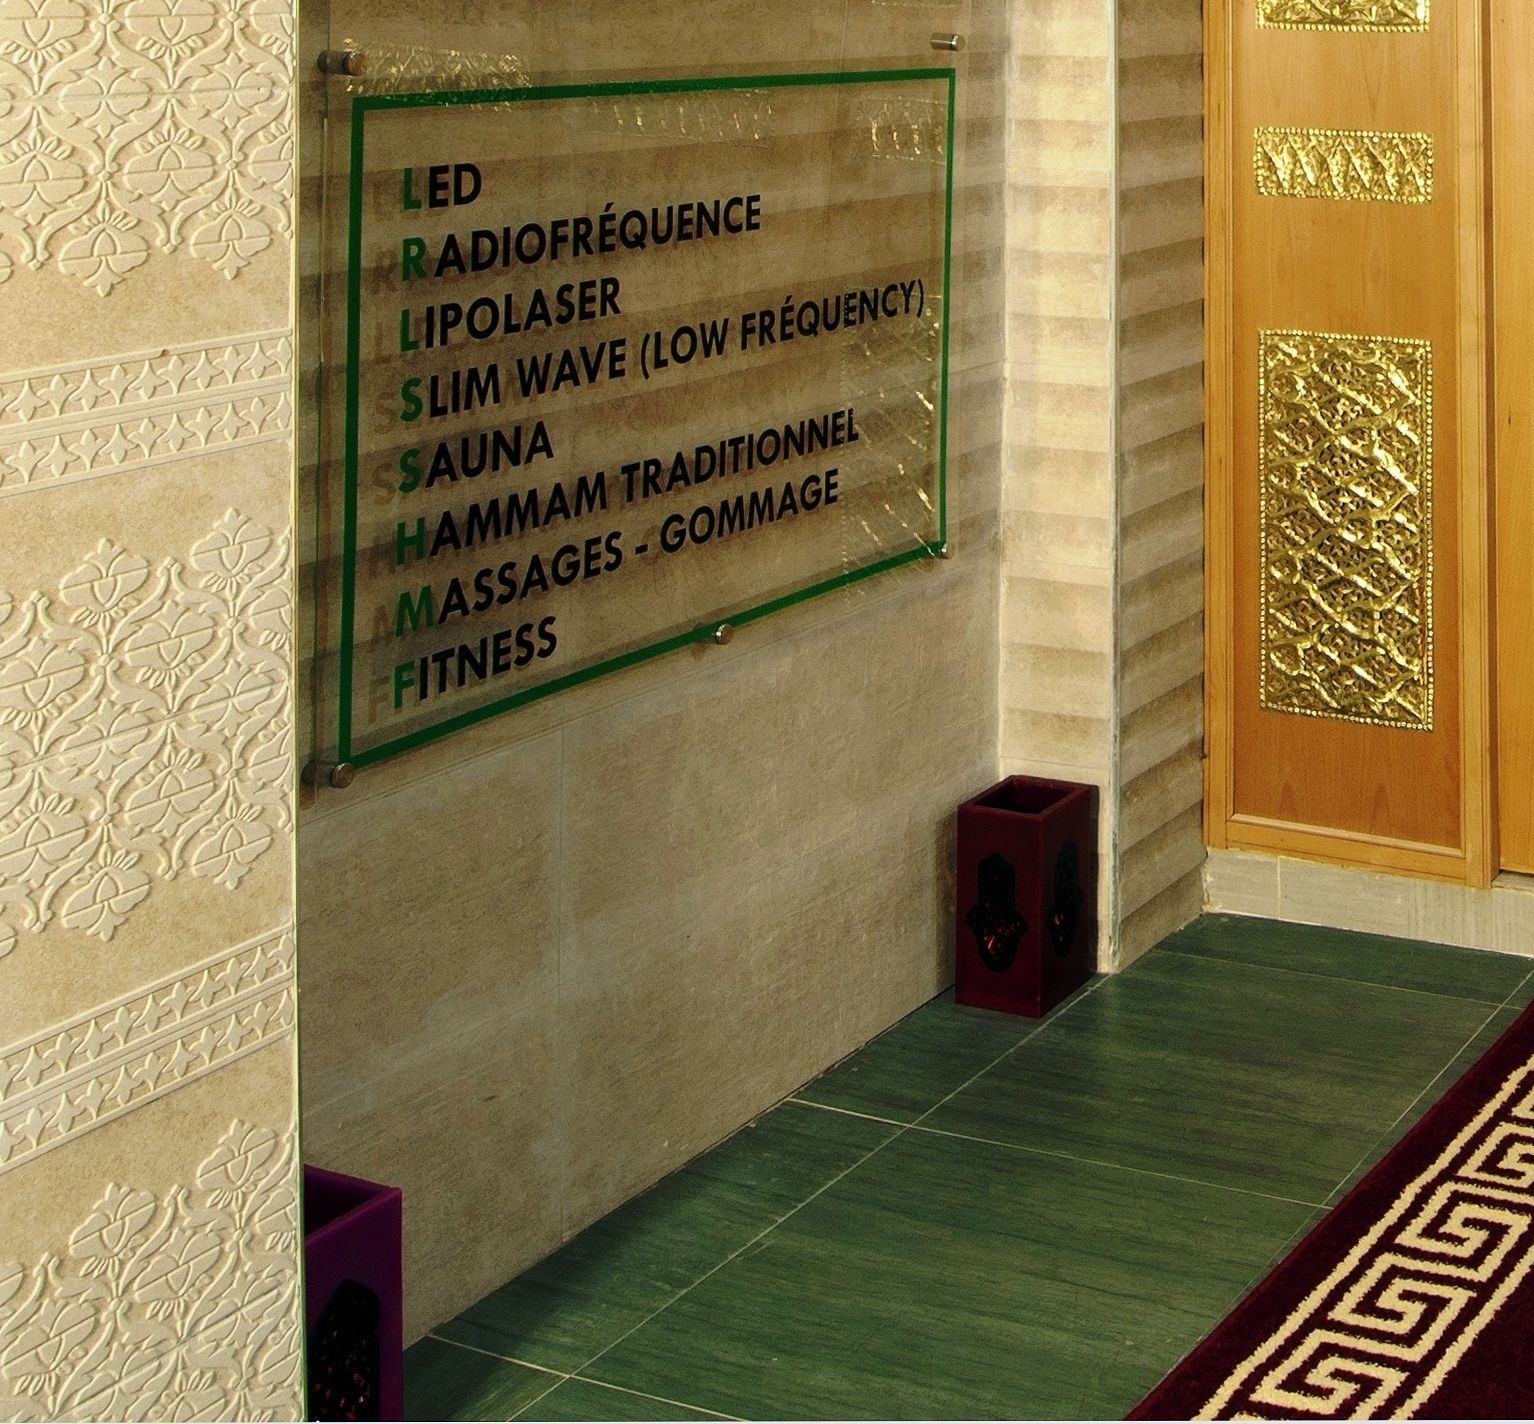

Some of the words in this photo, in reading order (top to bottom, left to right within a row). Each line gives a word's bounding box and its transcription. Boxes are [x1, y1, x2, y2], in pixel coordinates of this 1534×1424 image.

[401, 162, 483, 211] LED
[400, 194, 762, 281] RADIOFRÉQUENCE
[400, 276, 621, 352] LIPOLASER
[400, 364, 501, 423] SLIM
[516, 336, 627, 399] WAVE
[639, 316, 729, 380] (LOW
[738, 278, 927, 352] FRÉQUENCY)
[397, 471, 607, 566] HAMMAM
[620, 407, 860, 505] TRADITIONNEL
[399, 420, 554, 494] SAUNA
[395, 529, 623, 638] MASSAGES
[634, 542, 649, 556] -
[659, 468, 840, 555] GOMMAGE
[393, 614, 558, 709] FITNESS
